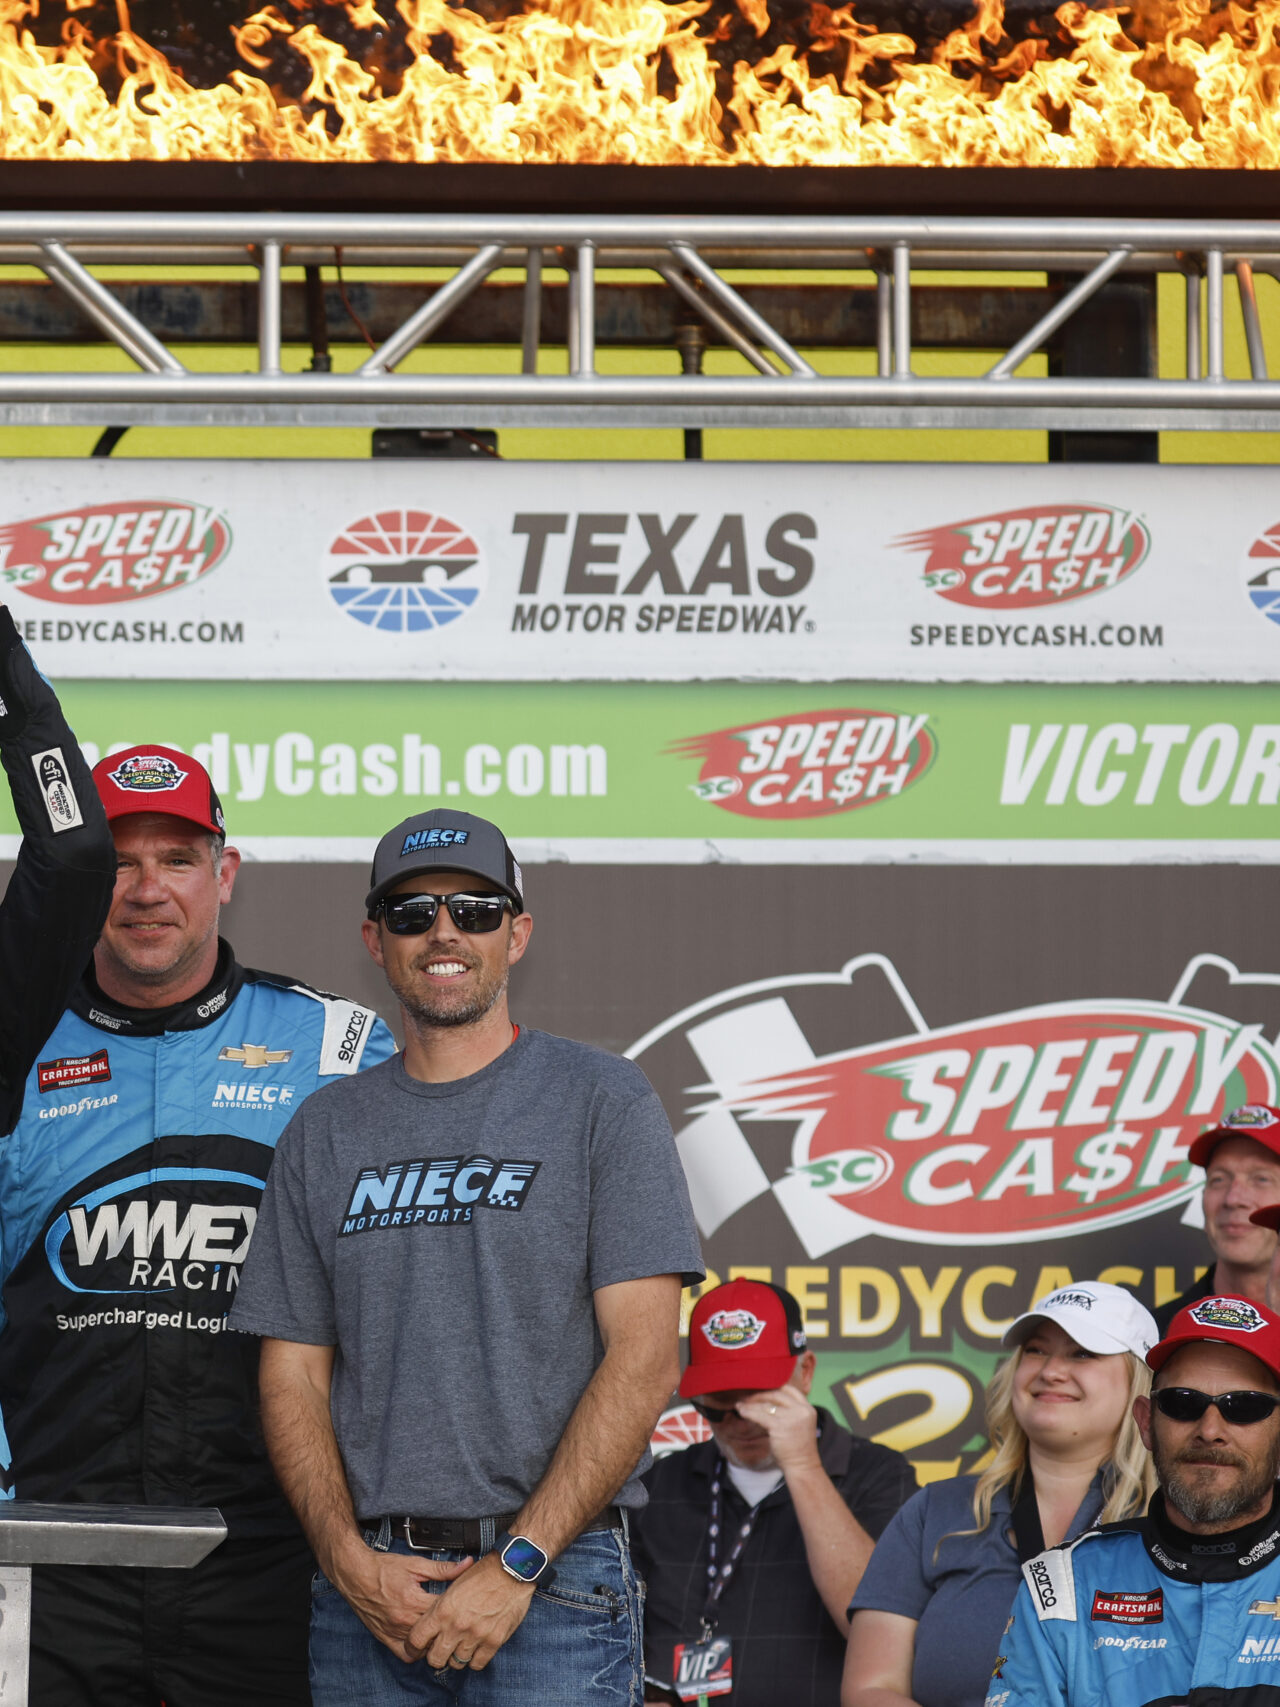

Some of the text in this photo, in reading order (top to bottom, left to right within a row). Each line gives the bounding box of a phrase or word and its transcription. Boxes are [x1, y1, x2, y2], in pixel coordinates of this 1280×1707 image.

[41, 505, 219, 561] SPEEDY
[963, 510, 1144, 566] SPEEDY
[512, 512, 818, 598] TEXAS
[511, 603, 807, 633] MOTOR SPEEDWAY
[16, 620, 245, 643] EEDYCASH.COM
[910, 624, 1164, 647] SPEEDYCASH.COM
[739, 713, 931, 775] SPEEDY
[43, 759, 62, 781] sfi
[121, 770, 176, 779] SPEEDYCASH.COM
[133, 775, 163, 784] 250
[404, 829, 467, 849] NIECE
[337, 1010, 368, 1064] sparco
[42, 1061, 108, 1082] CRAFTSMAN
[892, 1023, 1265, 1142] SPEEDY
[215, 1081, 297, 1105] NIECE
[39, 1094, 119, 1119] GOODYEAR
[211, 1100, 273, 1111] MOTORSPORTS
[348, 1158, 536, 1217] NIECE
[342, 1207, 473, 1234] MOTORSPORTS
[56, 1307, 183, 1331] Supercharged
[1211, 1313, 1240, 1323] 250
[1251, 1542, 1276, 1562] EXPRESS
[1029, 1560, 1057, 1611] sparco
[1096, 1601, 1162, 1613] CRAFTSMAN
[680, 1651, 720, 1683] VIP
